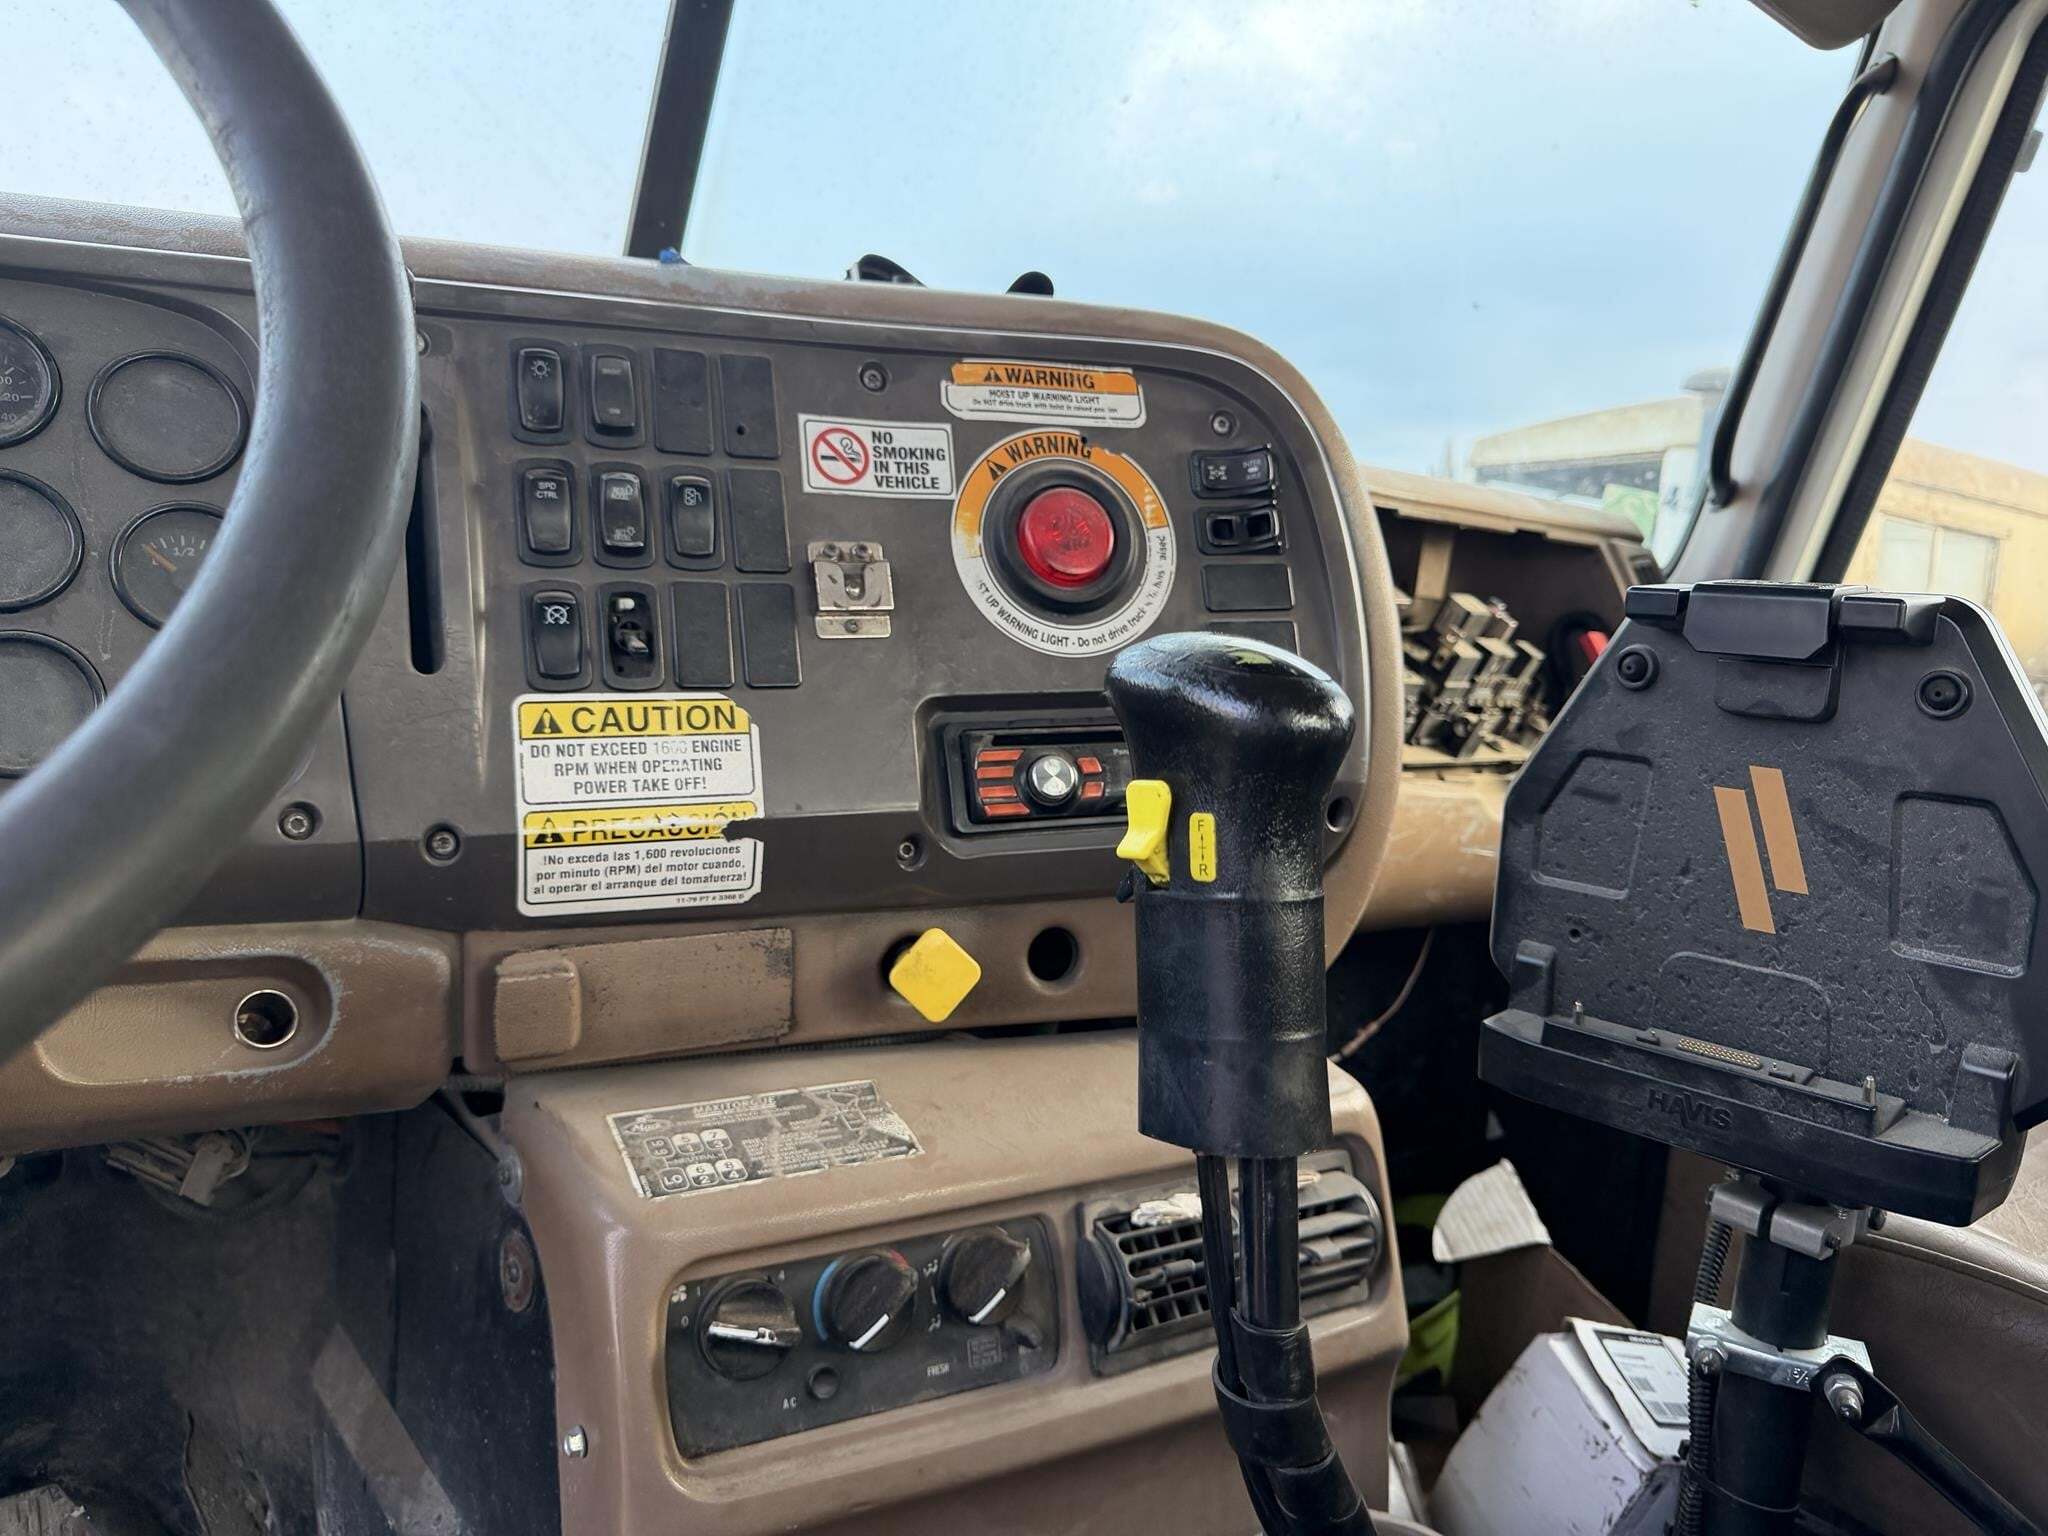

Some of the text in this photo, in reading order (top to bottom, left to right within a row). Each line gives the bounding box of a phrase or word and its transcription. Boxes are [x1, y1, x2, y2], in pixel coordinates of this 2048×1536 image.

[1004, 366, 1095, 390] WARNING
[872, 431, 893, 445] NO
[872, 446, 946, 461] SMOKING
[1004, 434, 1092, 464] WARNING
[874, 460, 930, 475] IN THIS
[873, 475, 940, 490] VEHICLE
[985, 594, 1000, 608] UP
[996, 606, 1039, 640] WARNING
[1040, 632, 1070, 647] LIGHT
[1077, 637, 1090, 648] Do
[1092, 634, 1107, 647] not
[1107, 624, 1129, 640] drive
[571, 705, 737, 734] CAUTION
[530, 744, 551, 758] DO
[556, 744, 585, 757] NOT
[591, 742, 647, 756] EXCEED
[692, 739, 742, 752] ENGINE
[554, 763, 589, 777] RPM
[594, 760, 638, 774] WHEN
[573, 776, 707, 795] POWER TAKE OFF!
[1197, 820, 1205, 832] F
[567, 850, 610, 864] exceda
[613, 849, 632, 862] las
[670, 844, 742, 859] revoluciones
[536, 871, 557, 882] por
[560, 867, 601, 879] minuto
[604, 863, 642, 880] (RPM)
[645, 862, 663, 874] del
[666, 861, 699, 872] motor
[1199, 863, 1208, 876] R
[534, 873, 748, 896] al operar el arranque del tomafuerza!
[1648, 1089, 1733, 1131] HAVIS
[664, 1174, 683, 1185] LO
[700, 1175, 711, 1183] 2
